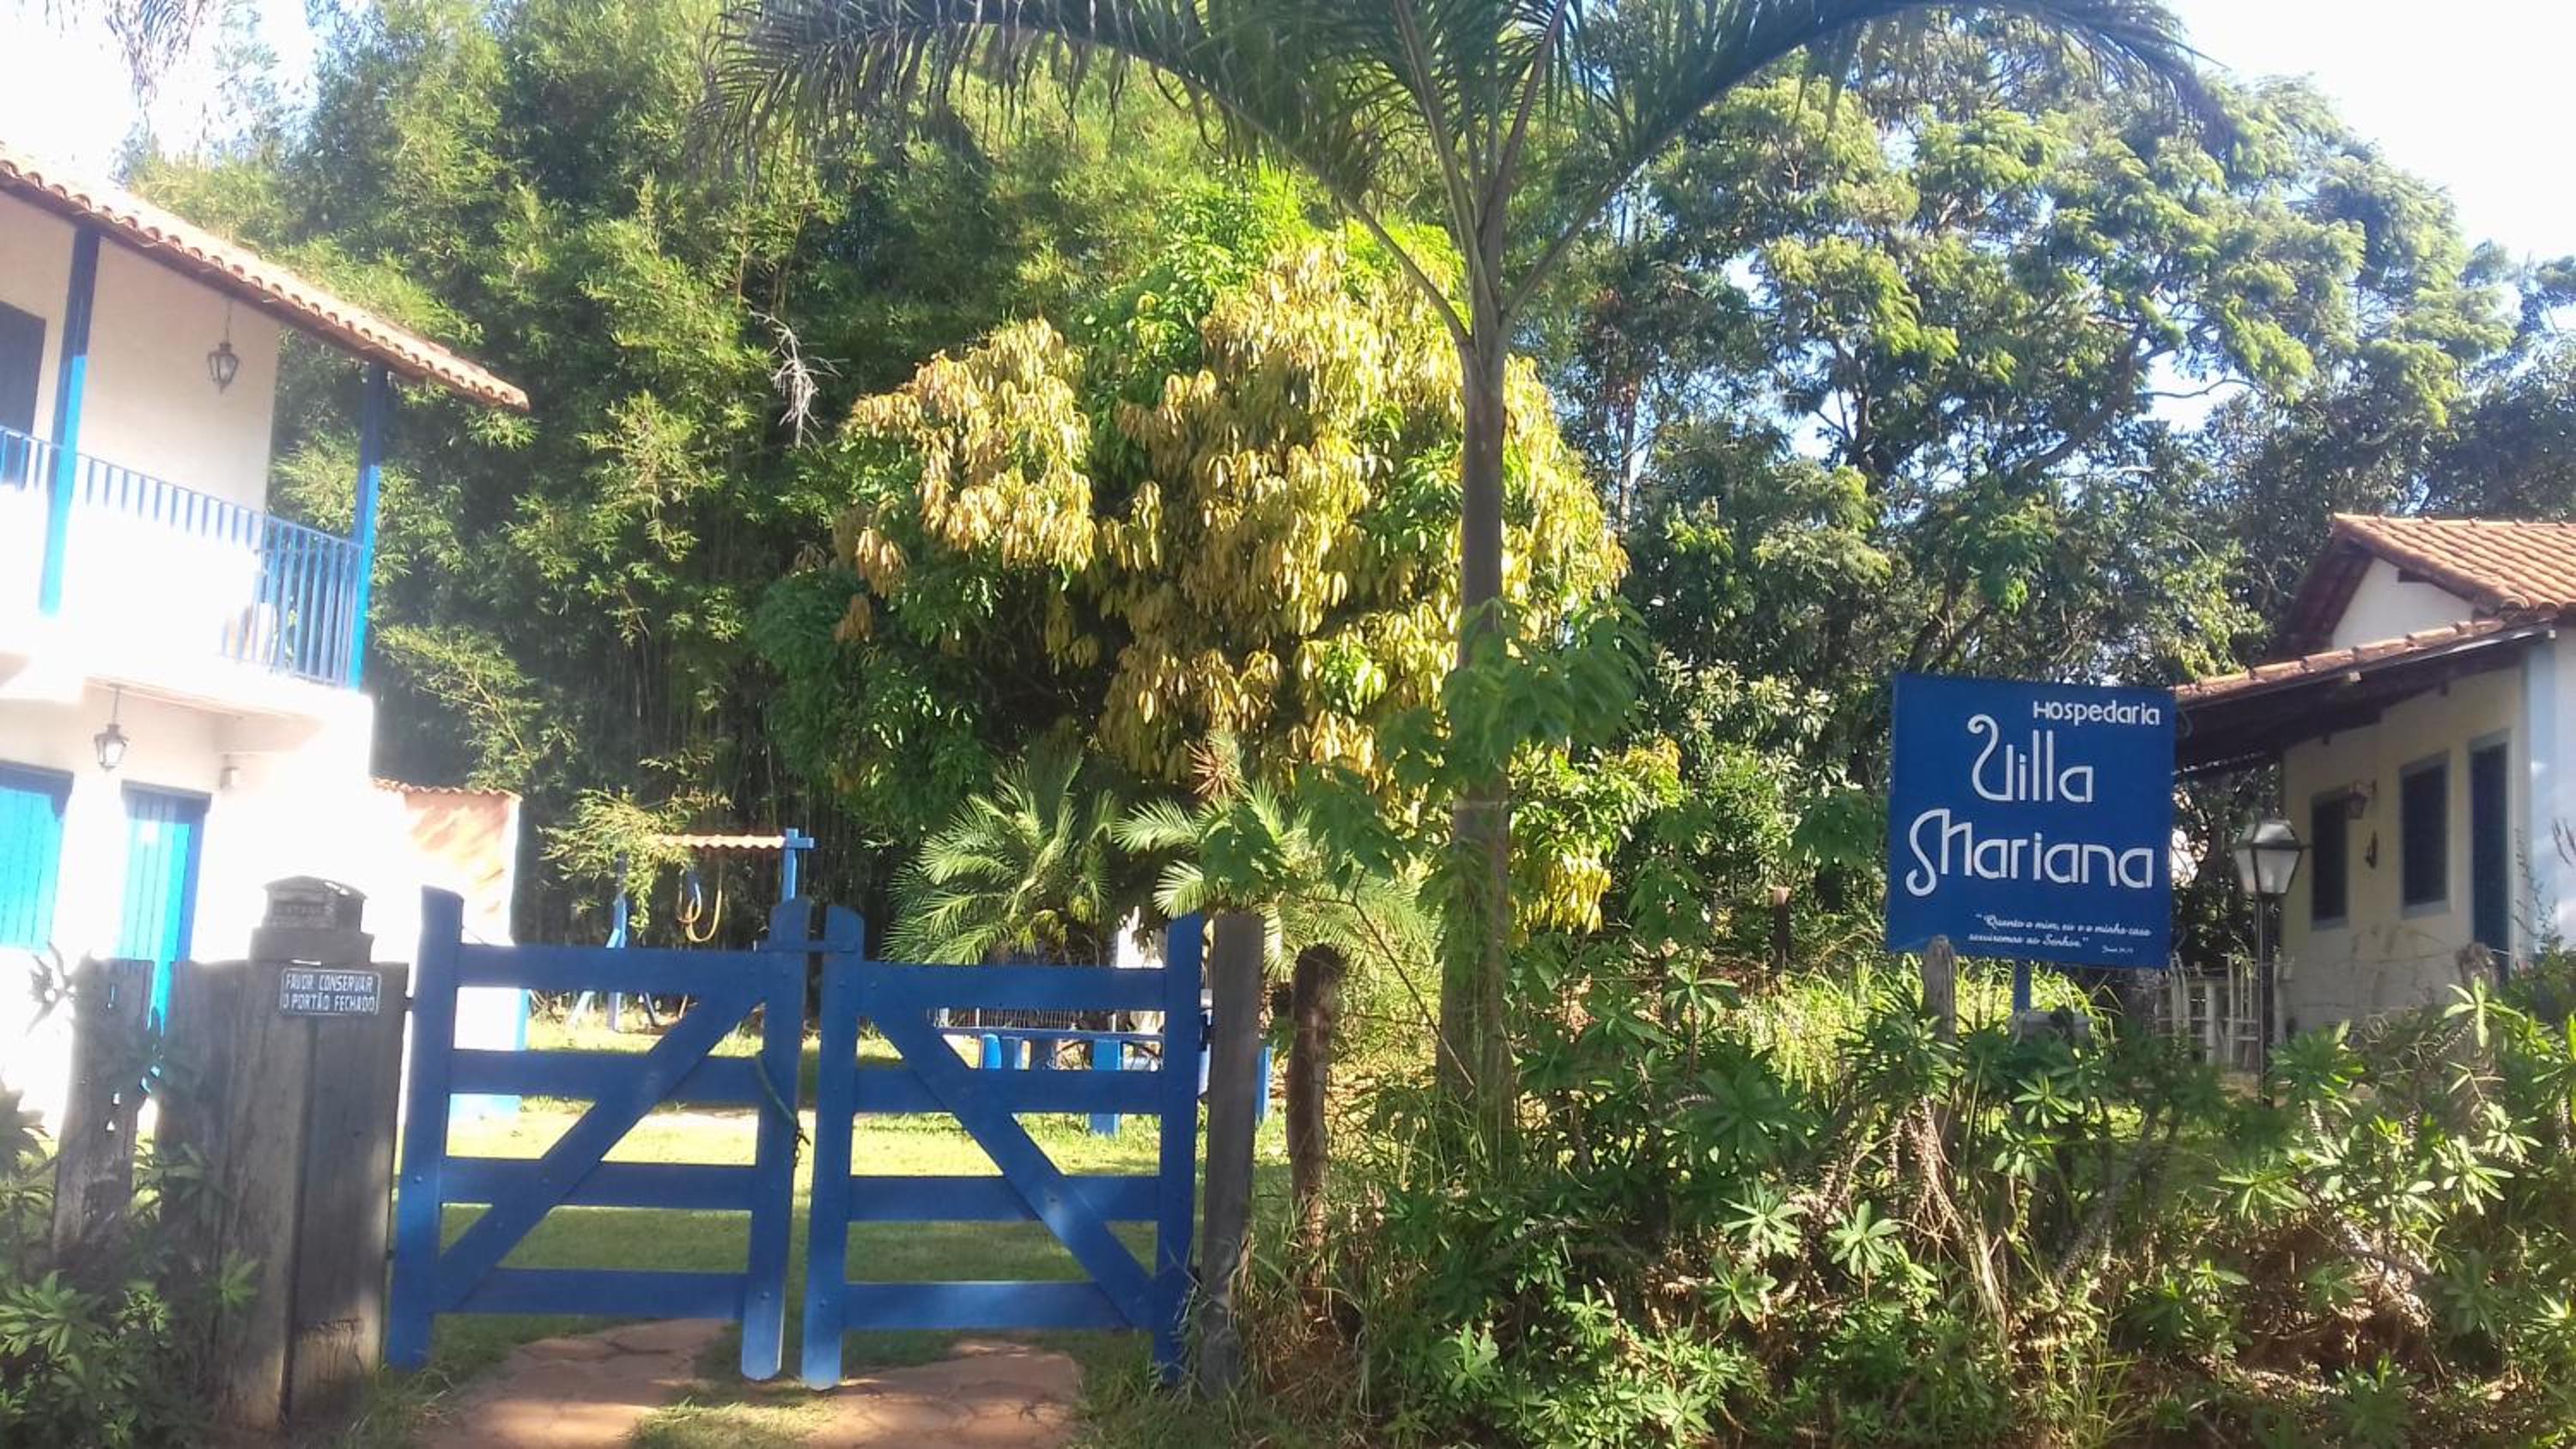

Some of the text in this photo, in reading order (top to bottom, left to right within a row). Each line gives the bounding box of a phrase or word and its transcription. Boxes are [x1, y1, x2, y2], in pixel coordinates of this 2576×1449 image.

[2033, 700, 2161, 726] Hospedaria
[1966, 713, 2094, 803] Villa
[1905, 808, 2155, 898] Mariana
[286, 973, 374, 993] FAVOR CONSERVAR
[292, 991, 331, 1010] PORTÃO
[334, 995, 375, 1012] FECHADO
